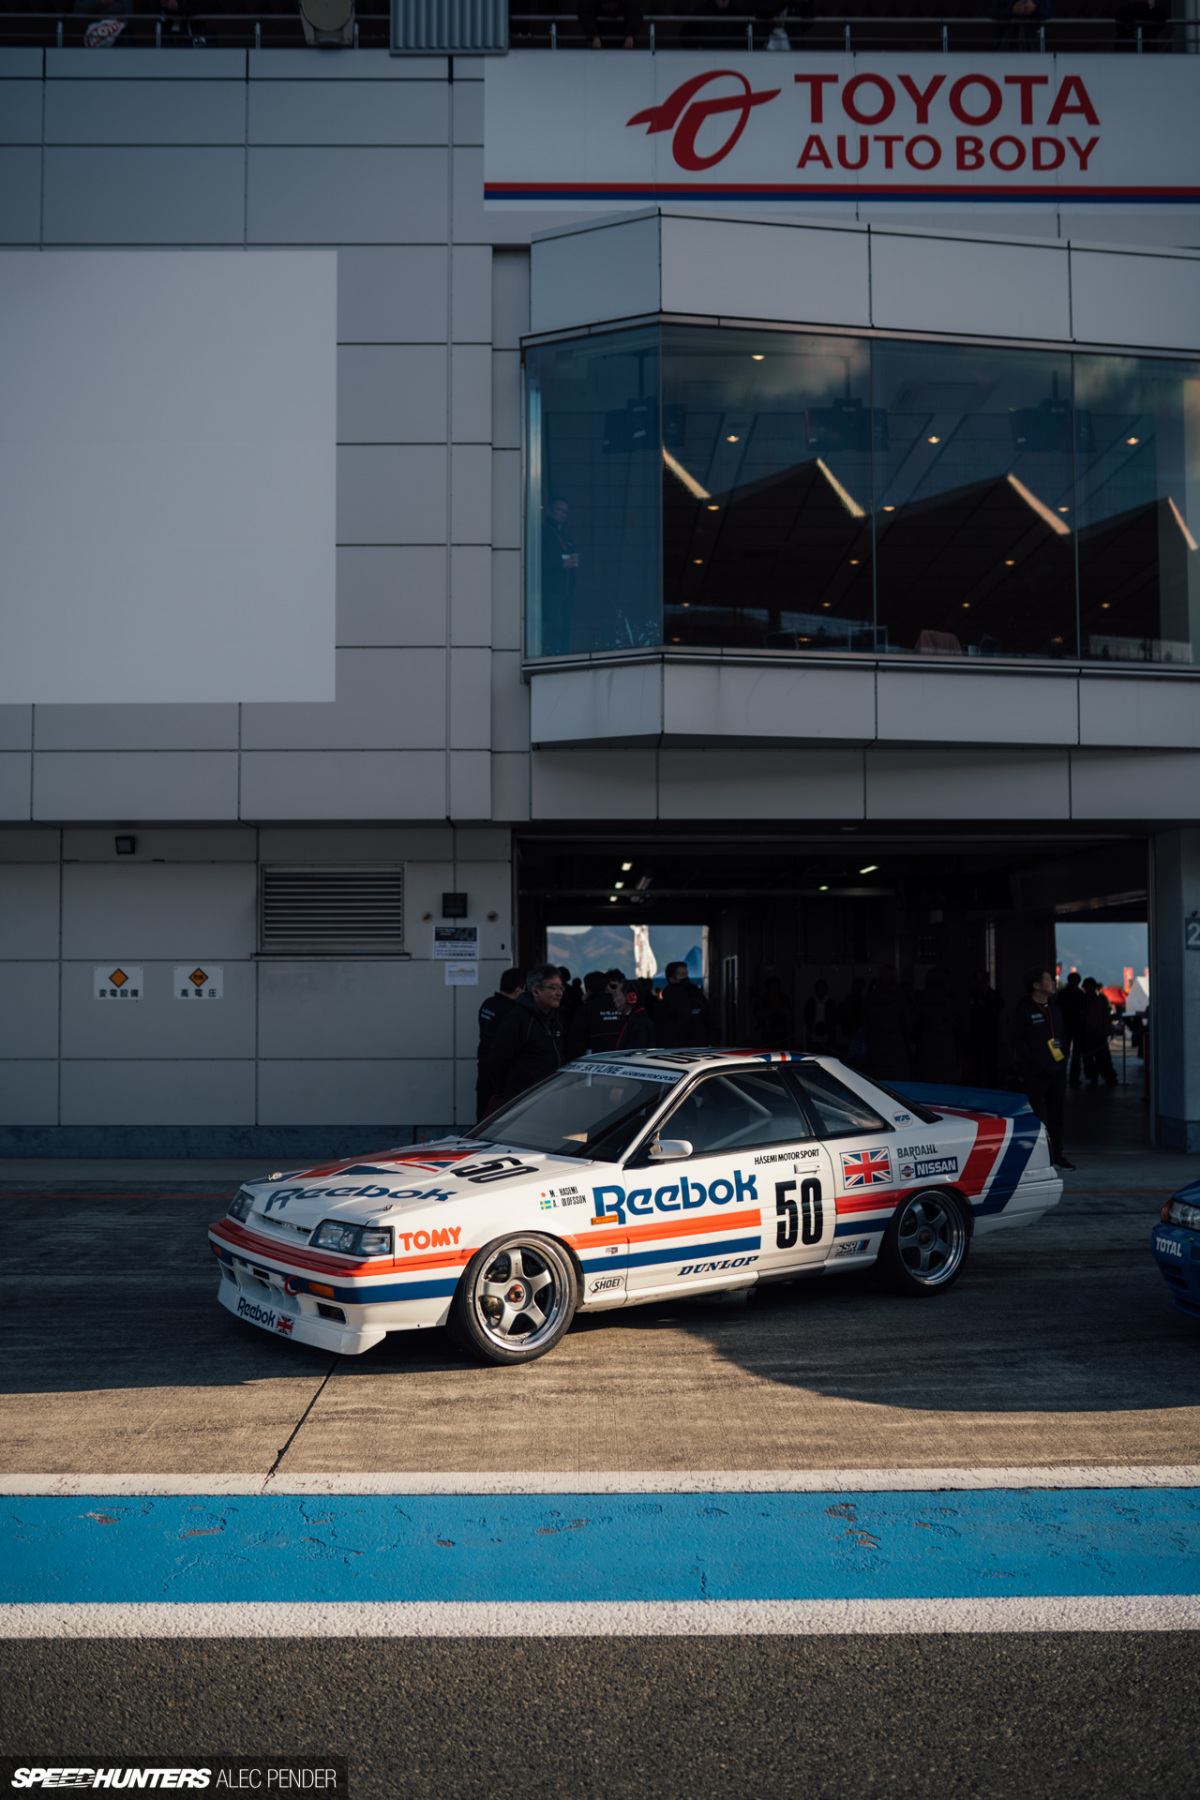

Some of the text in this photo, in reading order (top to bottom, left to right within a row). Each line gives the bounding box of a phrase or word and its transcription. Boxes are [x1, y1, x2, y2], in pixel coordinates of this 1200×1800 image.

[794, 73, 1101, 126] TOYOTA
[796, 134, 1100, 171] AUTO BODY
[99, 989, 139, 998] 変電設備
[180, 989, 217, 998] 高電圧
[583, 1064, 623, 1075] SKYLINE
[754, 1154, 778, 1165] HASEMI
[896, 1143, 939, 1160] BARDAHL
[450, 1156, 540, 1184] 50
[916, 1158, 957, 1177] NISSAN
[264, 1184, 459, 1213] Reebok
[549, 1185, 579, 1198] M. HASEMI
[552, 1194, 587, 1208] A. OLOFSSON
[592, 1169, 759, 1225] Reebok
[775, 1177, 824, 1249] 50
[398, 1226, 462, 1252] TOMY
[835, 1240, 858, 1254] SSR
[1155, 1236, 1182, 1258] TOTAL
[677, 1255, 760, 1277] DUNLOP
[593, 1278, 621, 1293] SHOEI
[237, 1296, 276, 1328] Reebok
